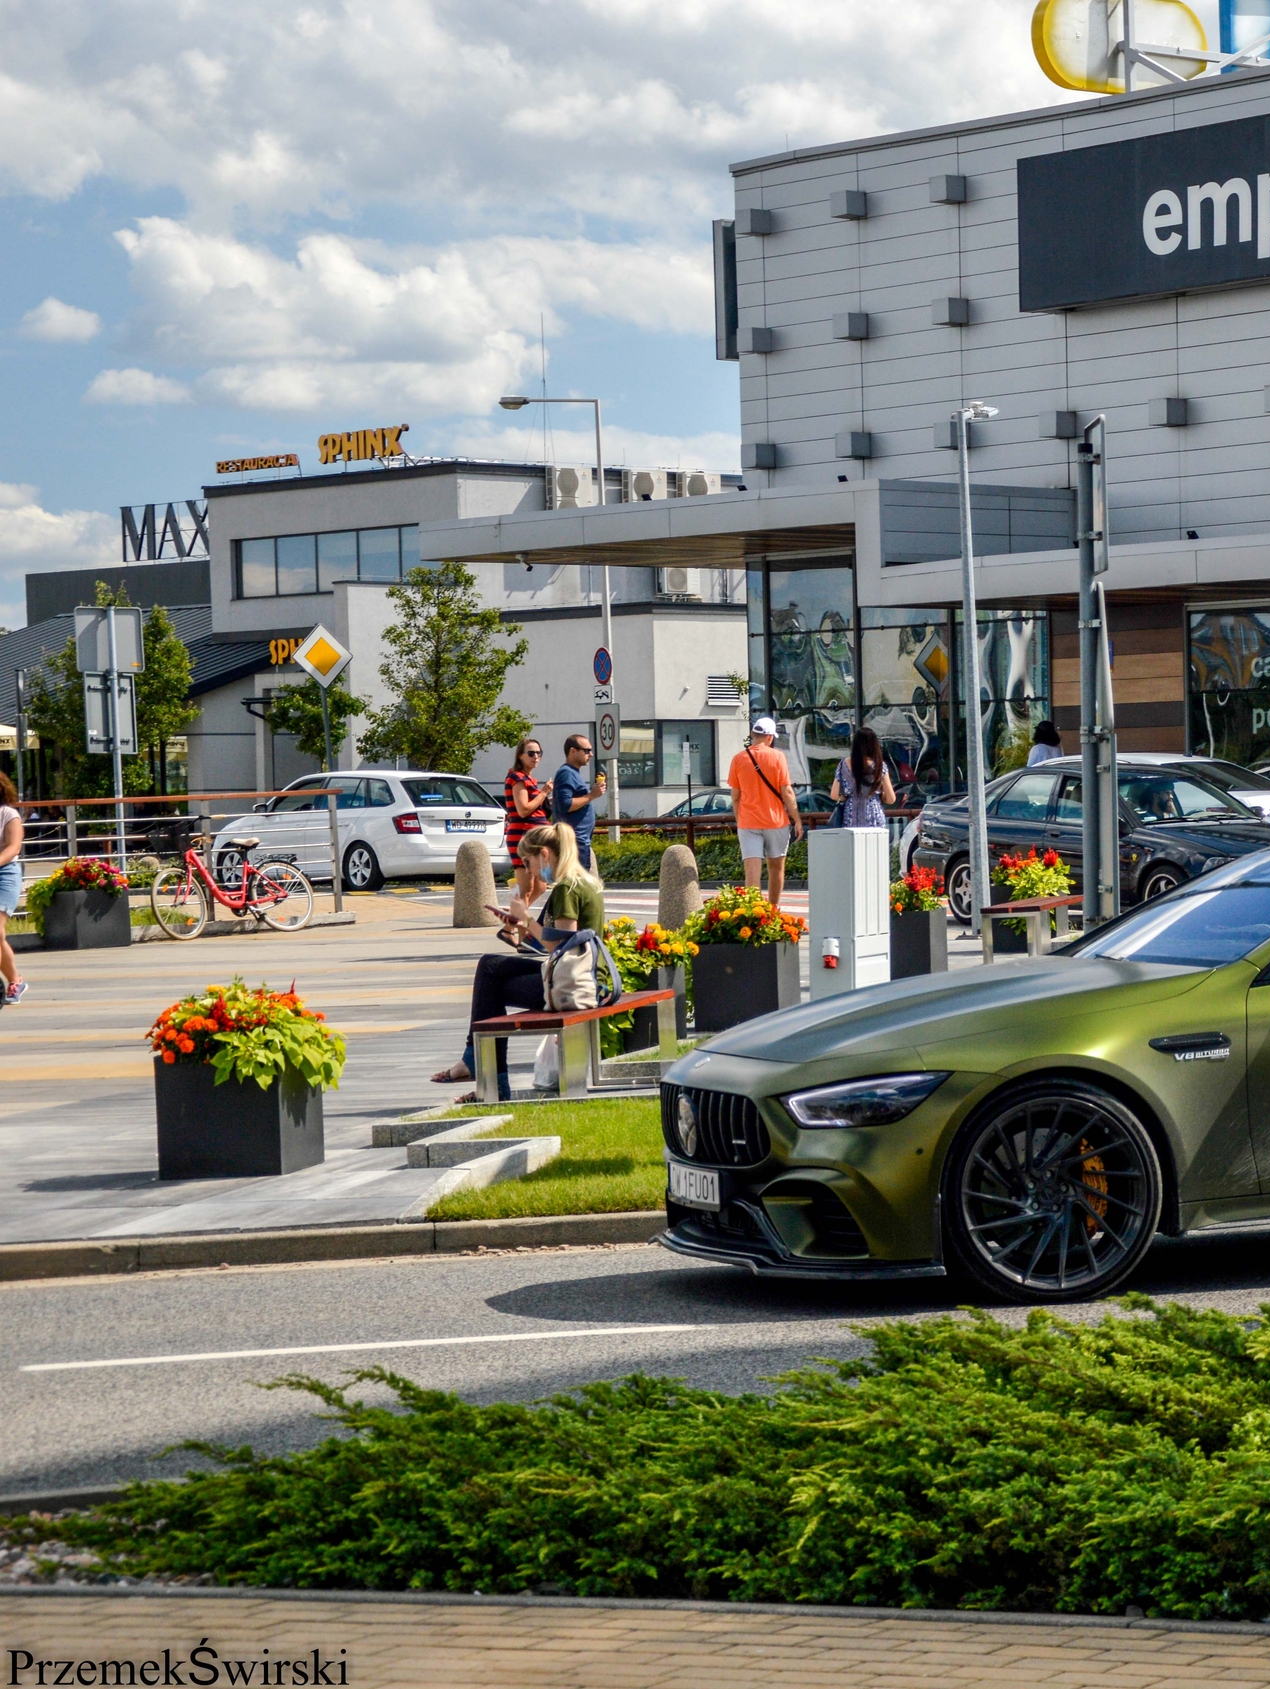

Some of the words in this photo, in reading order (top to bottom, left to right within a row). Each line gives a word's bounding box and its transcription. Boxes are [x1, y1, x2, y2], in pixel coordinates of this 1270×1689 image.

[318, 426, 404, 464] SPHINX
[216, 454, 298, 474] RESTAURACJA
[602, 723, 613, 741] 30
[1174, 1052, 1194, 1061] V8
